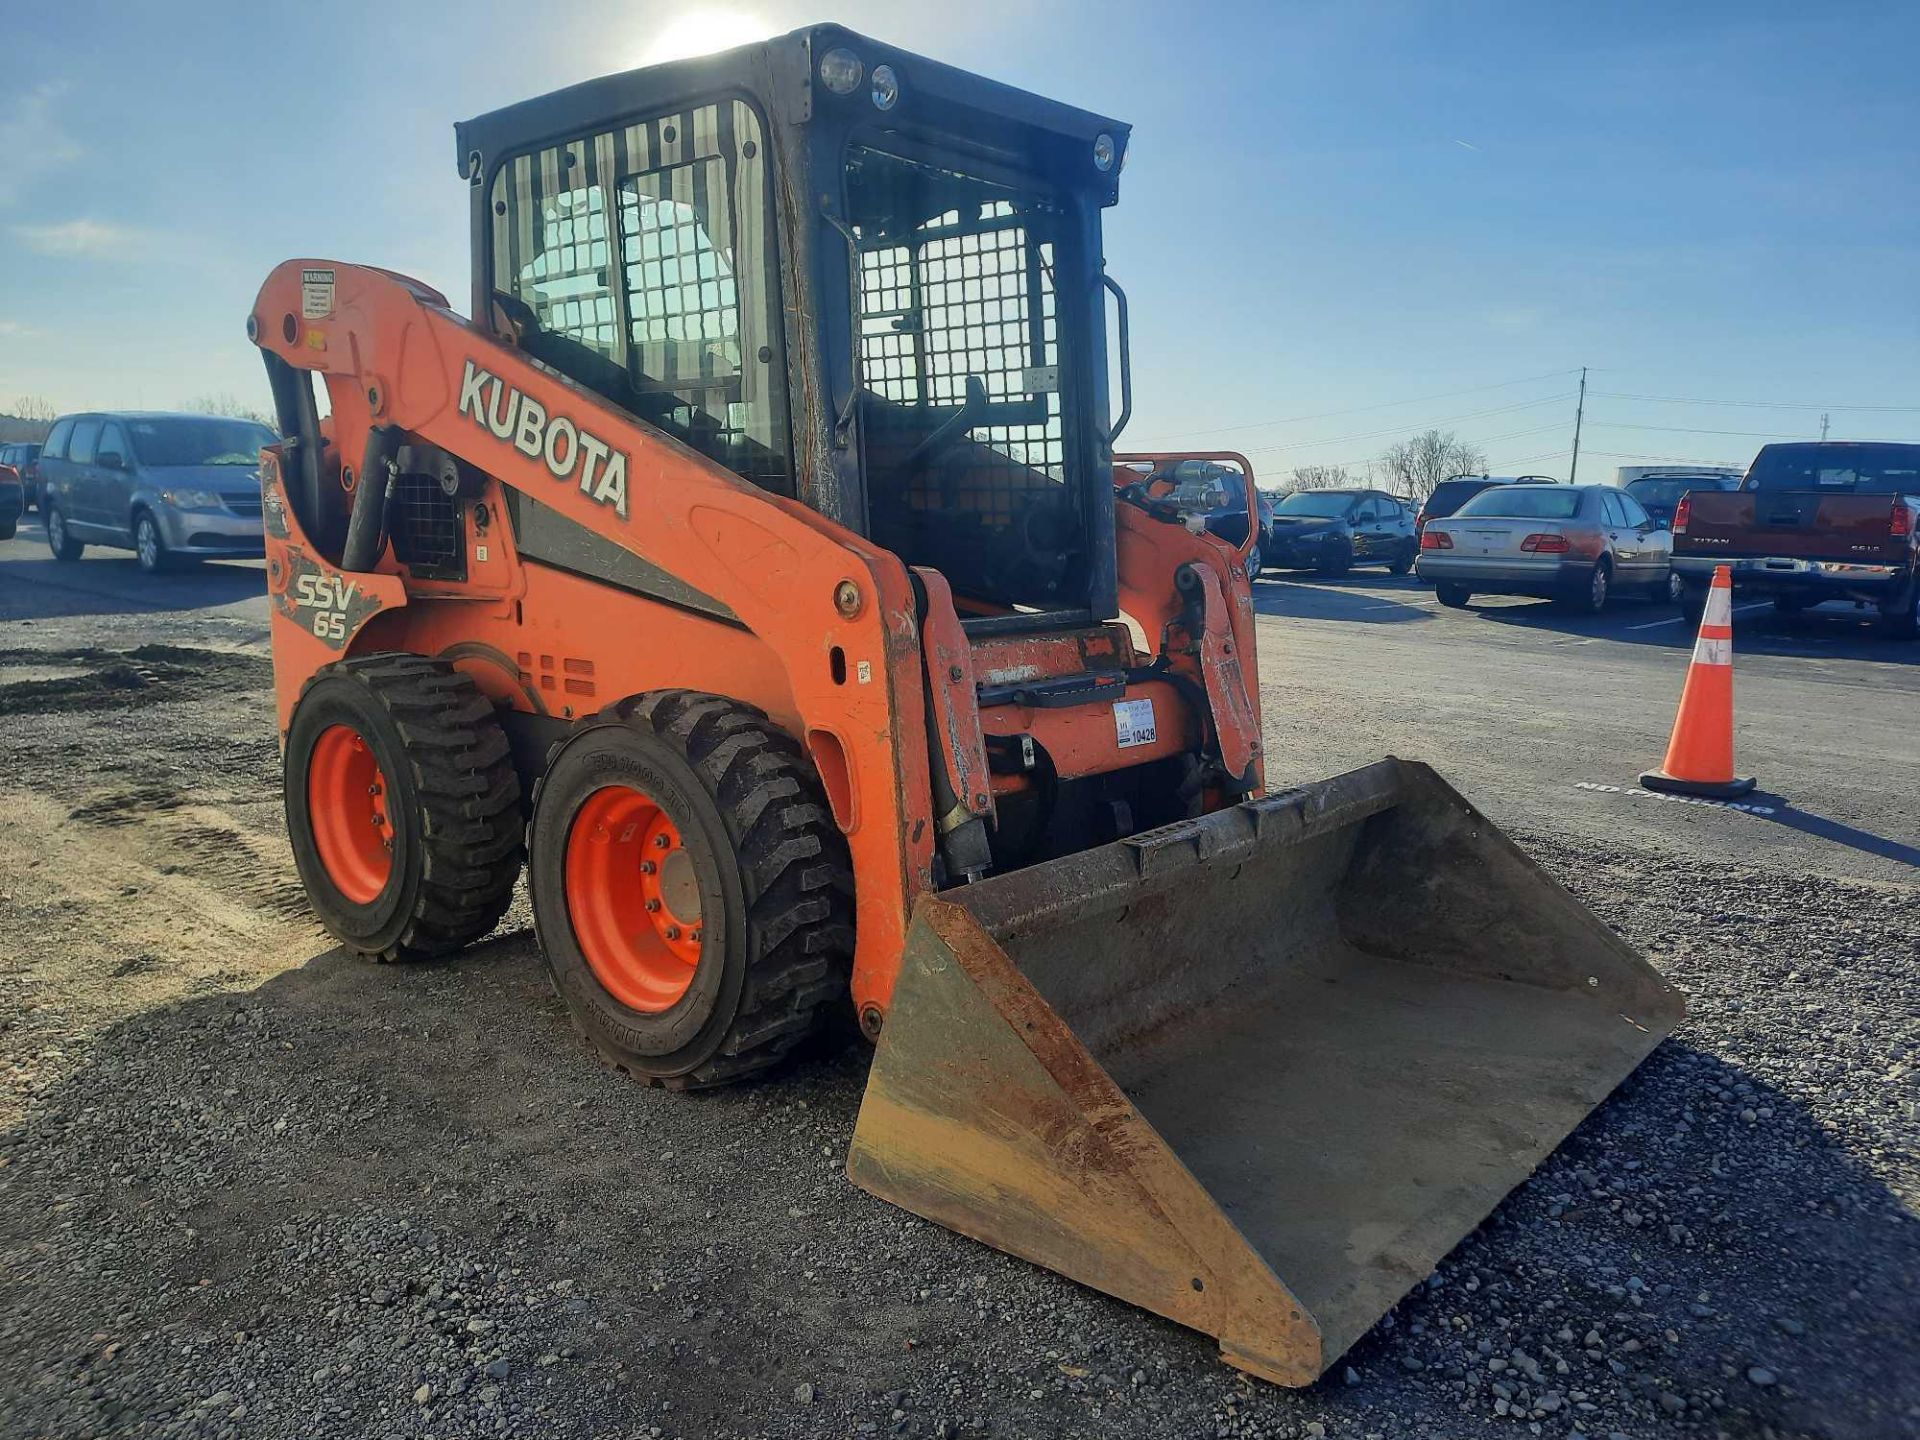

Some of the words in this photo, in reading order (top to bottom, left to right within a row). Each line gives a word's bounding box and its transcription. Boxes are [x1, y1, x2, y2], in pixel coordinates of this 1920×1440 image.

[470, 151, 482, 186] 2
[304, 272, 333, 283] WARNING
[459, 360, 628, 516] KUBOTA
[295, 574, 357, 611] SSV
[313, 611, 346, 640] 65
[1132, 728, 1155, 743] 10428
[1573, 781, 1621, 794] NO
[1624, 788, 1775, 815] PARKING
